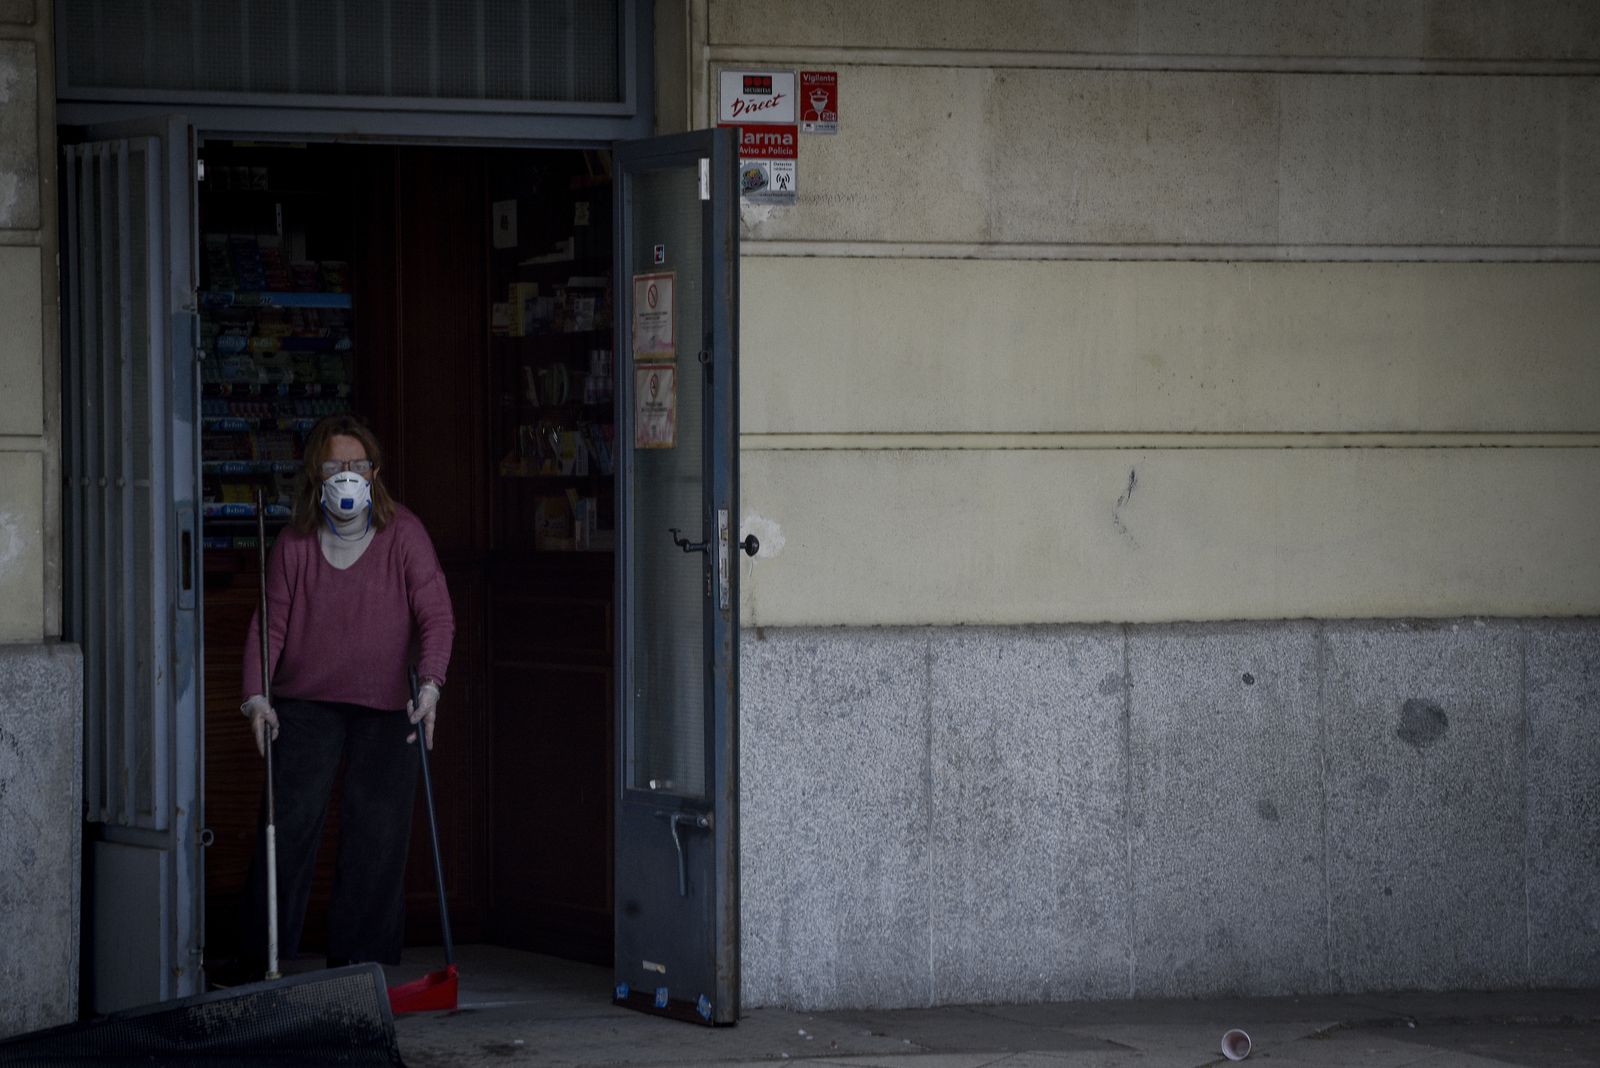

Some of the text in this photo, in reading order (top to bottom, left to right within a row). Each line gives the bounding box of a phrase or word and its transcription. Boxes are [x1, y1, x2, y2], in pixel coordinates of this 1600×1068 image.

[803, 73, 835, 84] Vigilante
[731, 93, 786, 118] Direct
[739, 127, 793, 145] larma
[739, 145, 759, 154] Aviso
